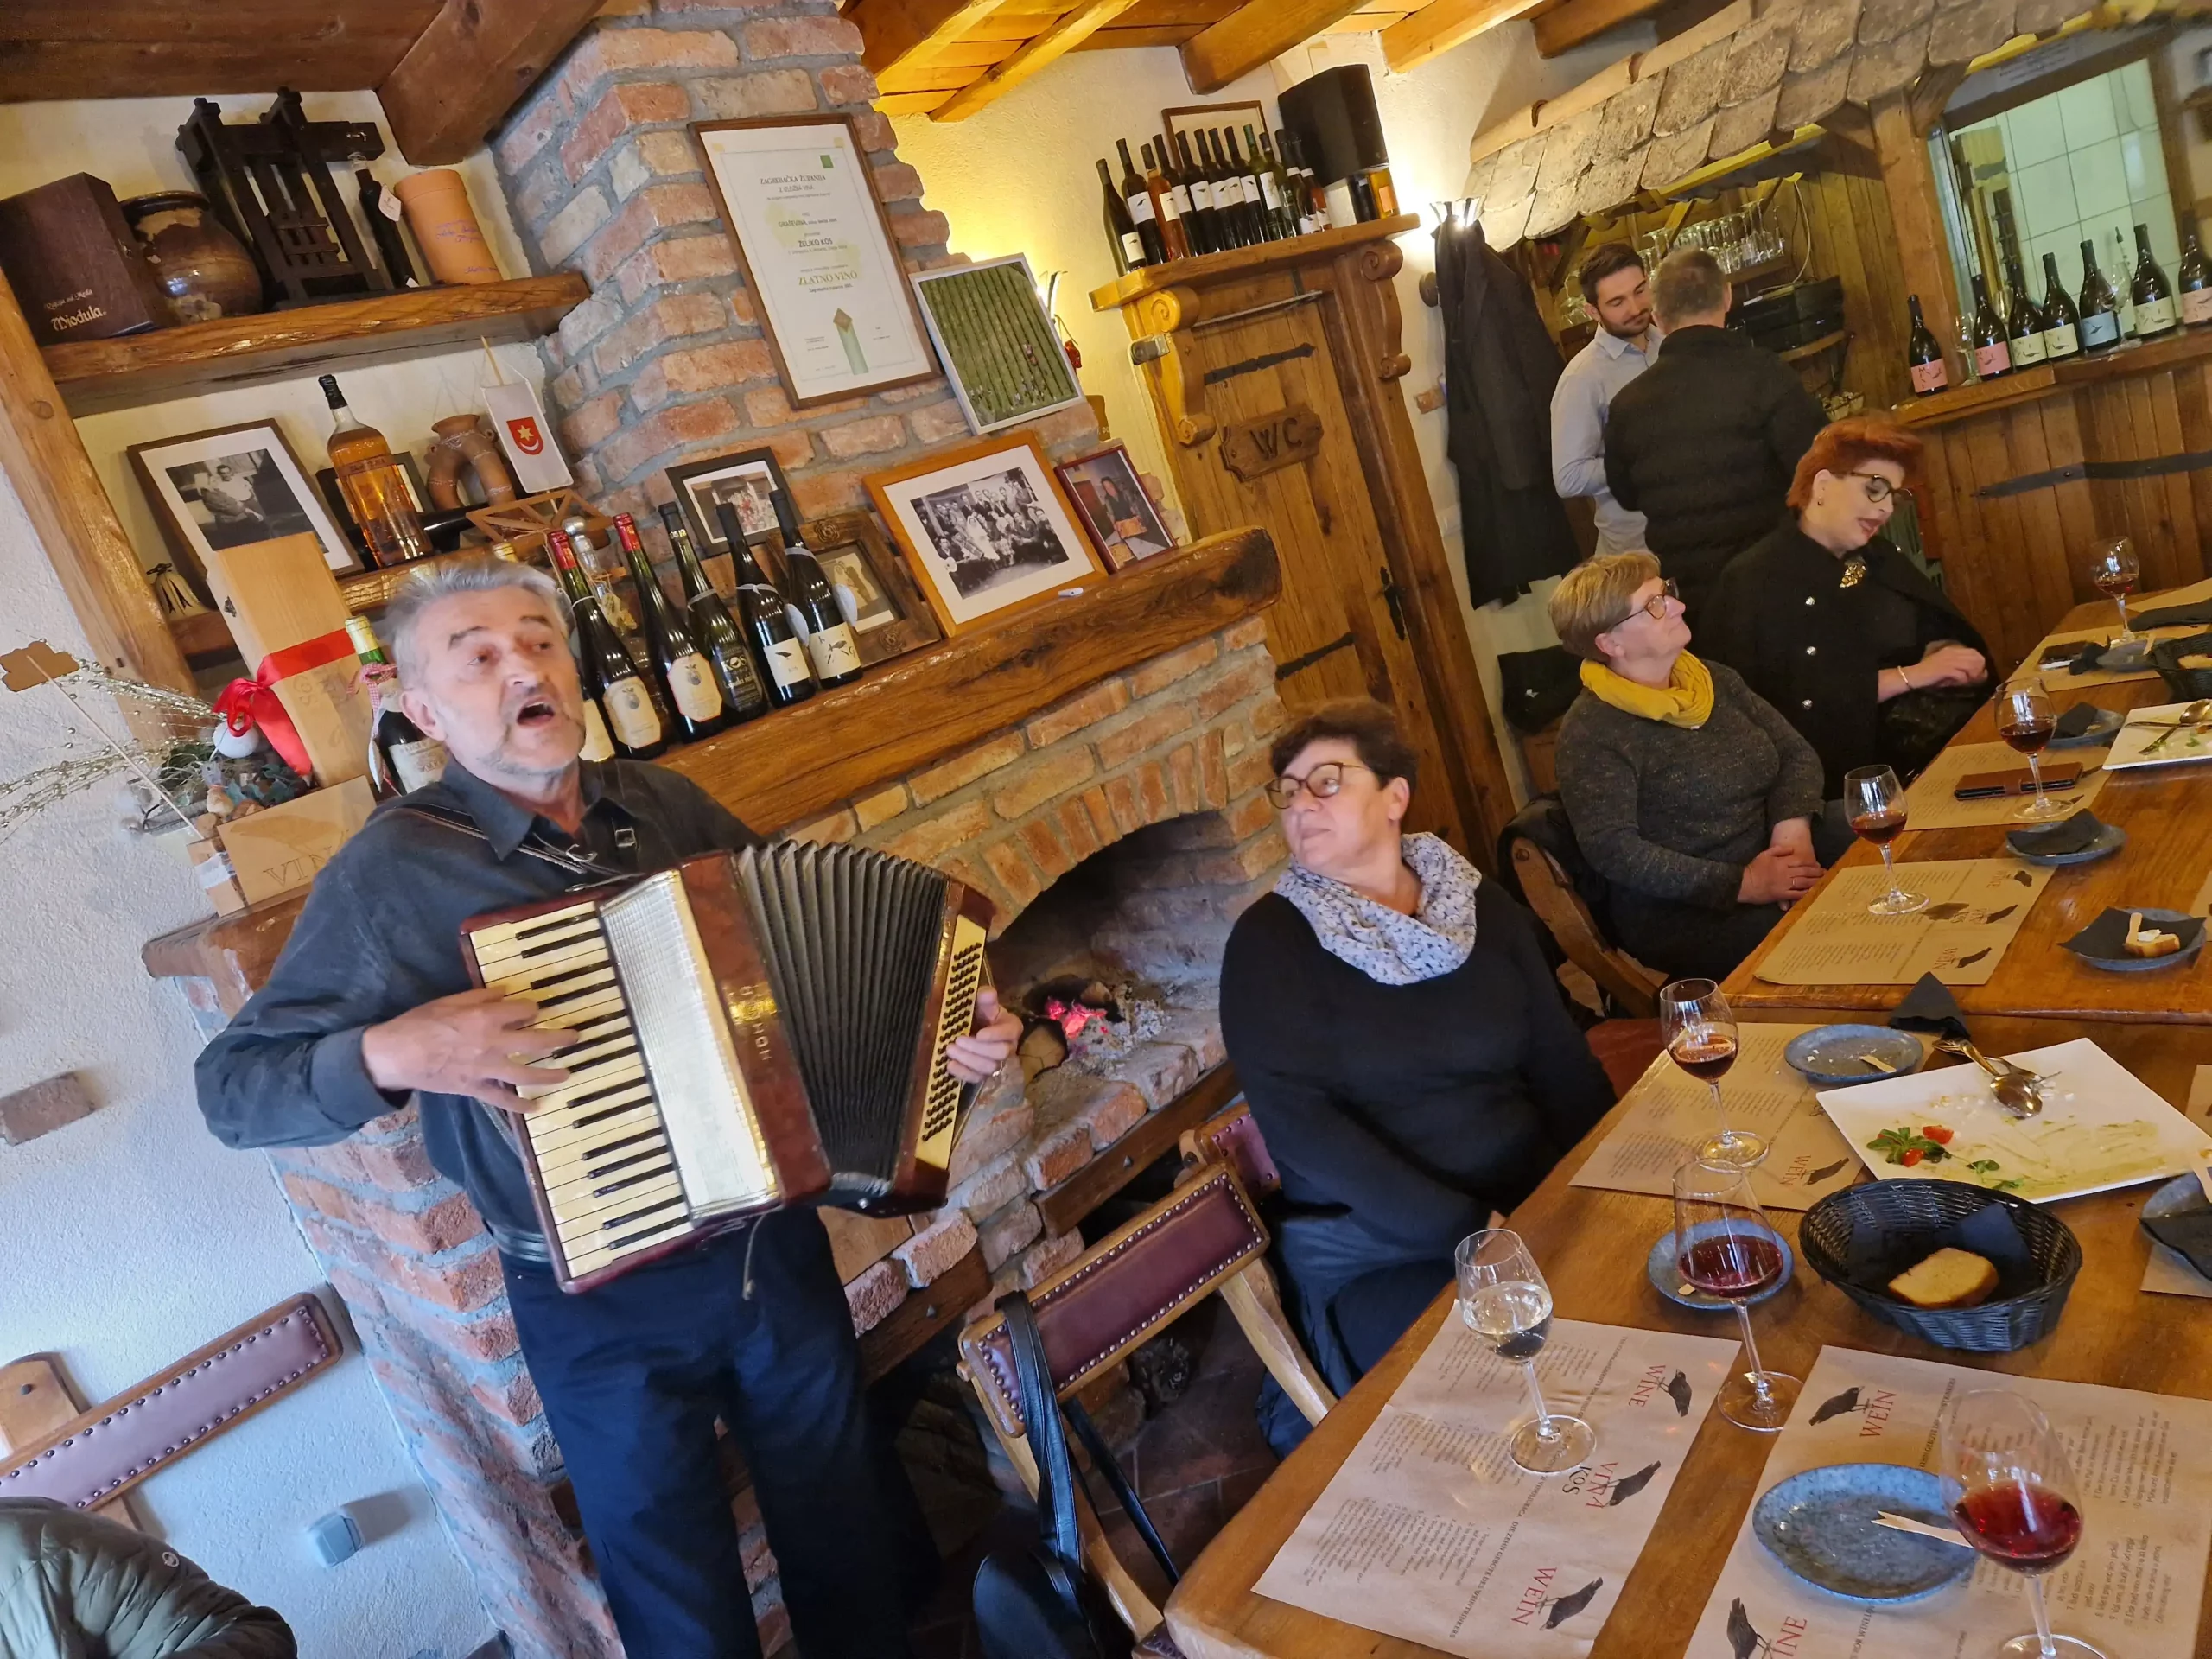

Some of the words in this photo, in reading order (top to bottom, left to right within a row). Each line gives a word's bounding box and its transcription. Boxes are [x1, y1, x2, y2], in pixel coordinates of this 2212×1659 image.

[798, 273, 834, 285] ZLATNO
[835, 270, 858, 282] VINO
[1249, 417, 1302, 461] WC
[1780, 1154, 1812, 1185] WEIN
[1625, 1363, 1668, 1408] WINE
[1859, 1389, 1897, 1439] WEIN
[1560, 1465, 1592, 1495] KOS
[1578, 1459, 1626, 1510] VINA
[1497, 1532, 1514, 1550] ZEHN
[1508, 1521, 1520, 1532] DIE
[1484, 1551, 1503, 1575] GEBOTE
[1477, 1576, 1489, 1588] DES
[1508, 1563, 1559, 1625] WEIN
[1447, 1589, 1481, 1637] WEINTRINKERS
